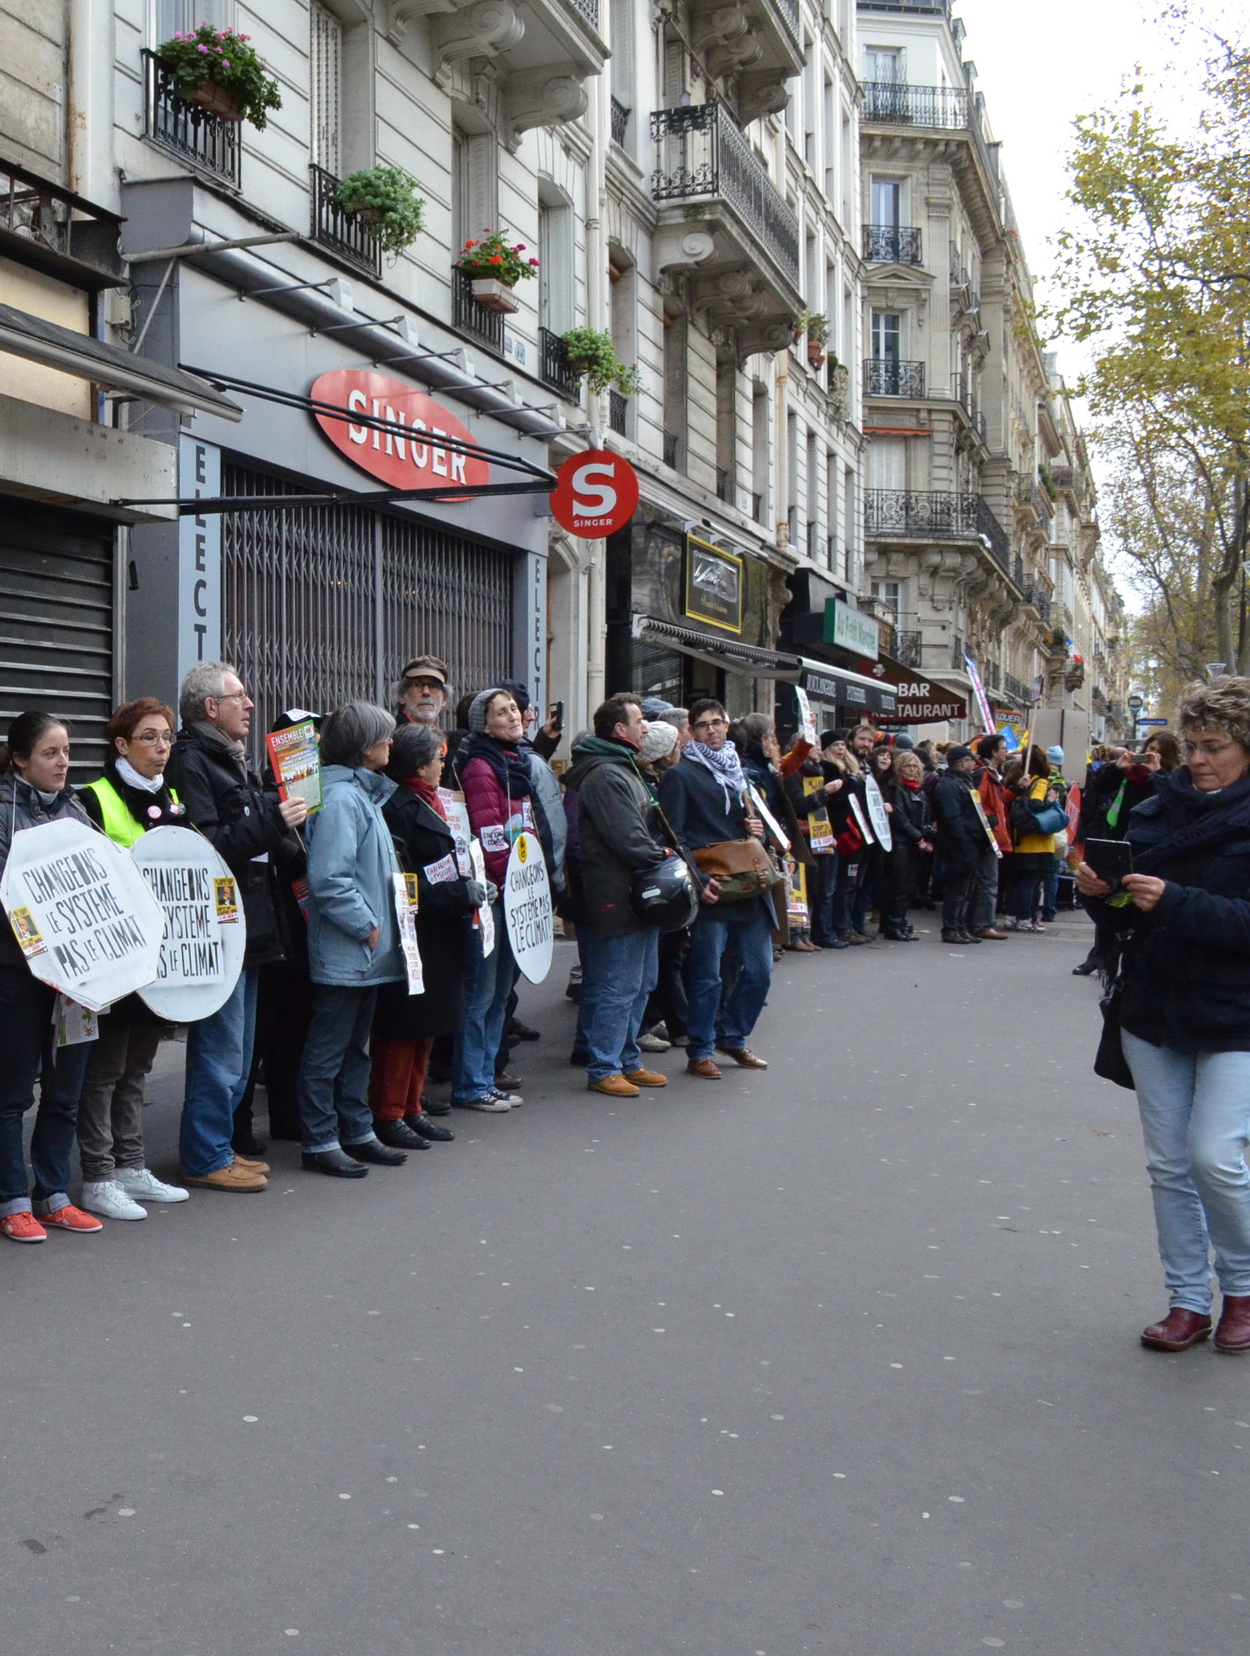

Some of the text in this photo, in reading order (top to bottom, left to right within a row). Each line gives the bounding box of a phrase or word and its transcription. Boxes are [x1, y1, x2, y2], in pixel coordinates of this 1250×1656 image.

[348, 389, 467, 485] SINGER
[572, 463, 617, 517] S
[574, 519, 613, 527] SINGER
[898, 683, 930, 697] BAR
[22, 848, 108, 904] CHANGEONS
[510, 860, 545, 892] CHANGEONS
[527, 887, 535, 900] LE
[539, 894, 550, 917] PAS
[46, 910, 62, 934] LE
[53, 939, 90, 979] PAS
[84, 940, 99, 961] LE
[94, 915, 147, 960] CLIMAT
[515, 927, 526, 953] LE
[170, 950, 178, 971] LE
[181, 942, 219, 977] CLIMAT
